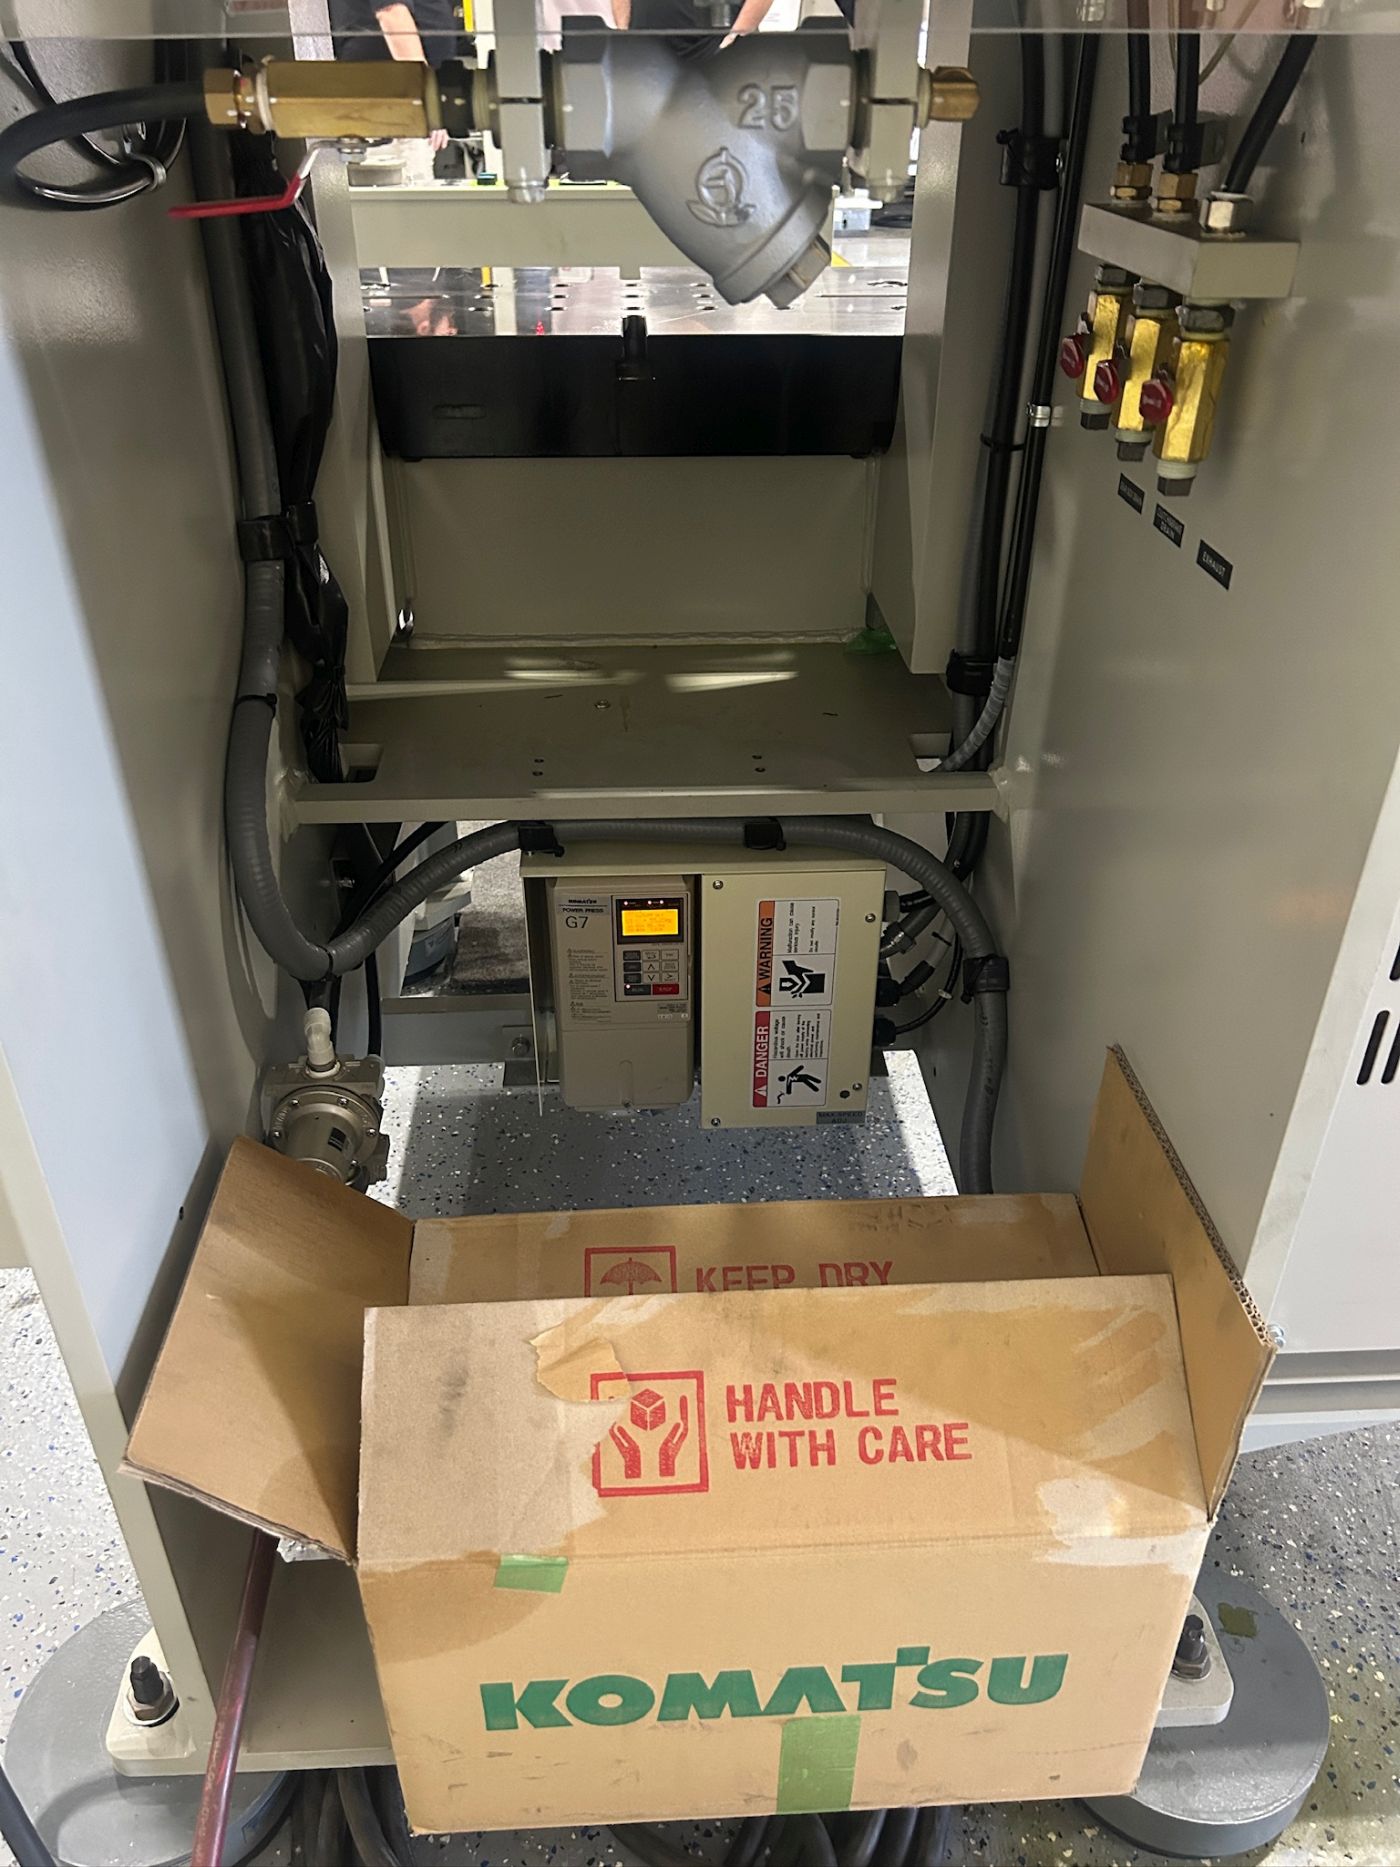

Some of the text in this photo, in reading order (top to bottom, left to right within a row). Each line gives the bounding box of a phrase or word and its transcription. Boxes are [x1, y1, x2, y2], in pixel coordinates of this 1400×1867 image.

[737, 82, 799, 132] 25
[565, 915, 589, 929] G7
[758, 917, 773, 980] WARNING
[755, 1026, 769, 1077] DANGER
[696, 1261, 894, 1293] KEEP DRY
[726, 1378, 899, 1423] HANDLE
[730, 1422, 973, 1469] WITH CARE
[480, 1646, 1068, 1731] KOMATSU
